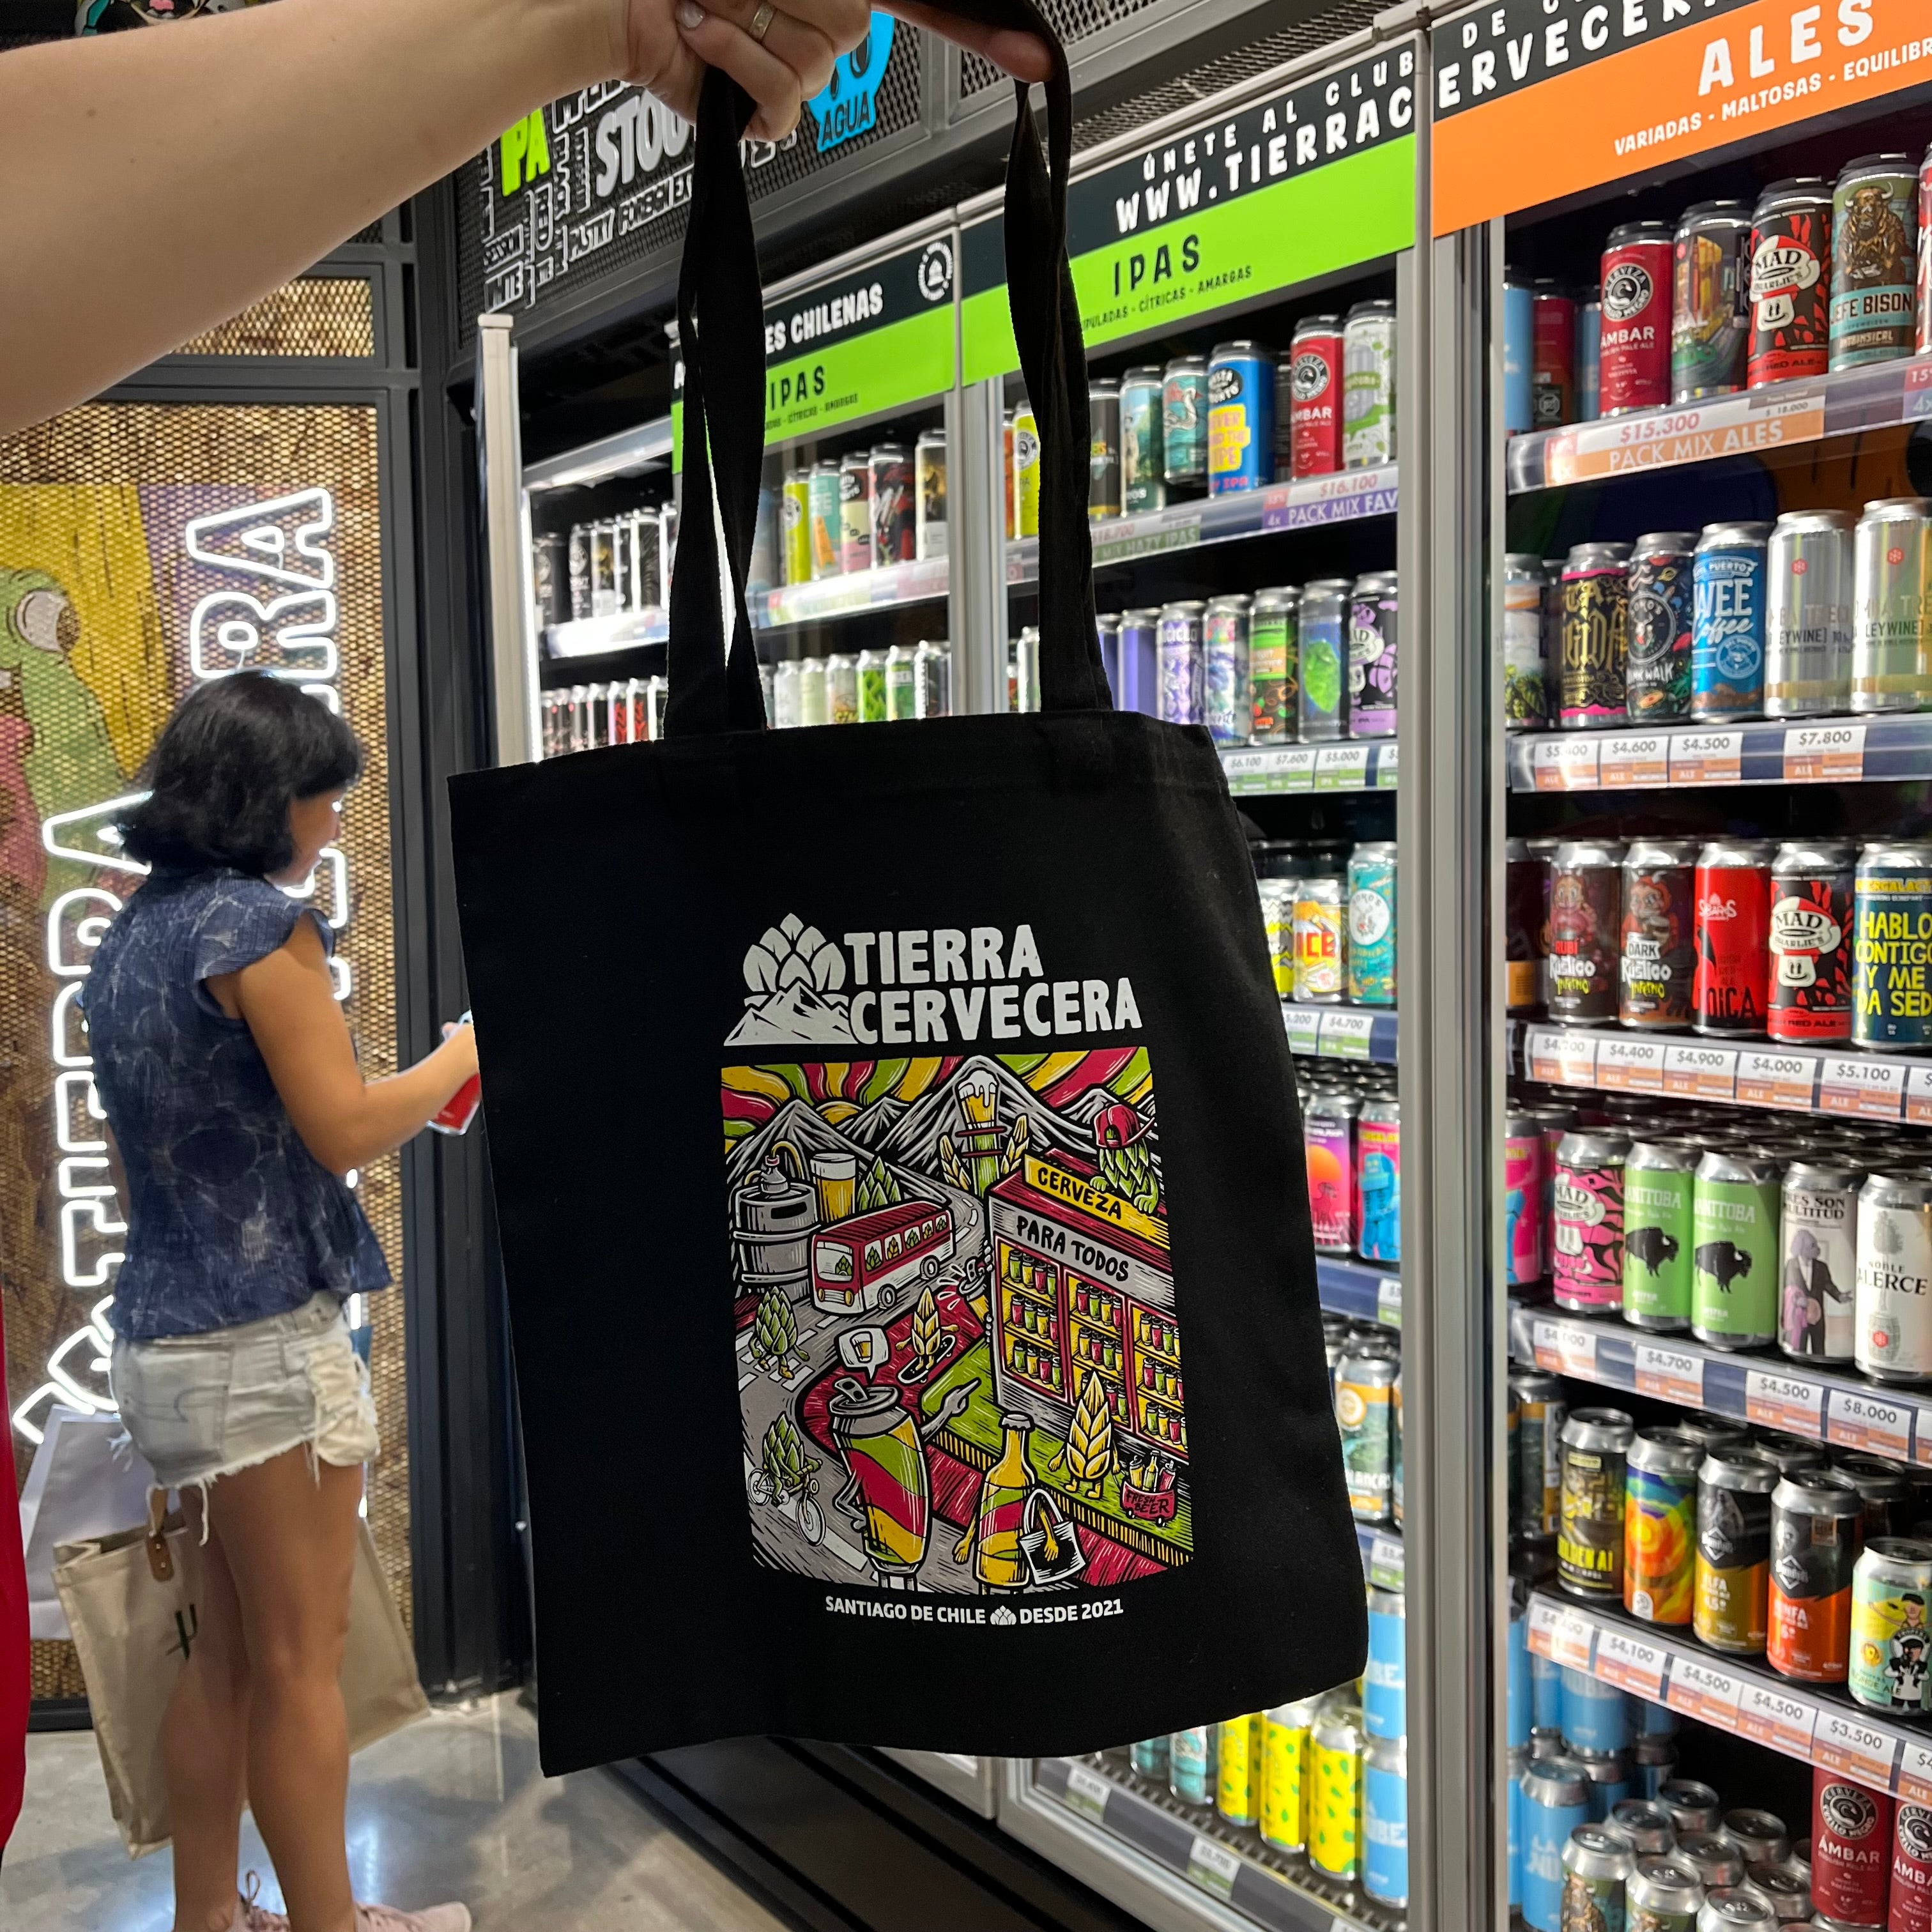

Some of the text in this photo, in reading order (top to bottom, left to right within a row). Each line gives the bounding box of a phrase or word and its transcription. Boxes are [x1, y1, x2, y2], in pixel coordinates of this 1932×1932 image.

[1462, 8, 1506, 49] DE
[1698, 0, 1873, 96] ALES
[818, 93, 871, 151] AGUA
[1143, 50, 1414, 181] ÚNETE AL CLUB
[1614, 112, 1701, 156] VARIADAS
[1722, 73, 1821, 121] MALTOSAS
[1114, 234, 1200, 297] IPAS
[1756, 250, 1802, 273] MAD
[1084, 306, 1128, 330] PULADAS
[1198, 266, 1252, 295] AMARGAS
[1863, 292, 1913, 316] BISON
[790, 282, 884, 344] CHILENAS
[770, 365, 825, 410] IPAS
[1912, 368, 1932, 383] 15
[1621, 413, 1700, 443] $15.300
[1610, 441, 1666, 471] PACK
[1674, 434, 1714, 460] MIX
[1724, 418, 1783, 451] ALES
[1320, 474, 1378, 497] $16.100
[1288, 503, 1328, 525] PACK
[1331, 498, 1360, 518] MIX
[1693, 578, 1753, 618] WEE
[1612, 740, 1657, 755] $4.600
[1682, 737, 1731, 751] $4.500
[1799, 730, 1852, 746] $7.800
[1324, 751, 1361, 764] $5.000
[1775, 913, 1823, 929] MAD
[1860, 912, 1932, 940] HABLO
[844, 924, 1043, 985] TIERRA
[1629, 943, 1657, 956] DARK
[1866, 965, 1925, 990] Y ME
[850, 977, 1142, 1045] CERVECERA
[1857, 989, 1932, 1016] DA SED
[1610, 1045, 1653, 1059] $4.400
[1676, 1050, 1724, 1066] $4.900
[1752, 1057, 1802, 1073] $4.000
[1837, 1064, 1891, 1081] $5.100
[1747, 1088, 1764, 1100] ALE
[1830, 1096, 1848, 1108] ALE
[1919, 1105, 1932, 1117] AL
[1038, 1167, 1121, 1220] CERVEZA
[1815, 1197, 1845, 1208] SON
[1016, 1215, 1129, 1281] PARA TODOS
[1646, 1350, 1693, 1372] $4.700
[1760, 1377, 1809, 1400] $4.500
[1843, 1398, 1897, 1424] $8.000
[1126, 1489, 1156, 1504] FRESH
[1134, 1498, 1170, 1514] BEER
[825, 1596, 1124, 1624] SANTIAGO DE CHILE DESDE 2021
[1610, 1637, 1654, 1664] $4.100
[1684, 1665, 1731, 1693] $4.500
[1754, 1691, 1803, 1720] $4.500
[1830, 1719, 1883, 1750] $3.500
[1909, 1786, 1928, 1800] ALE
